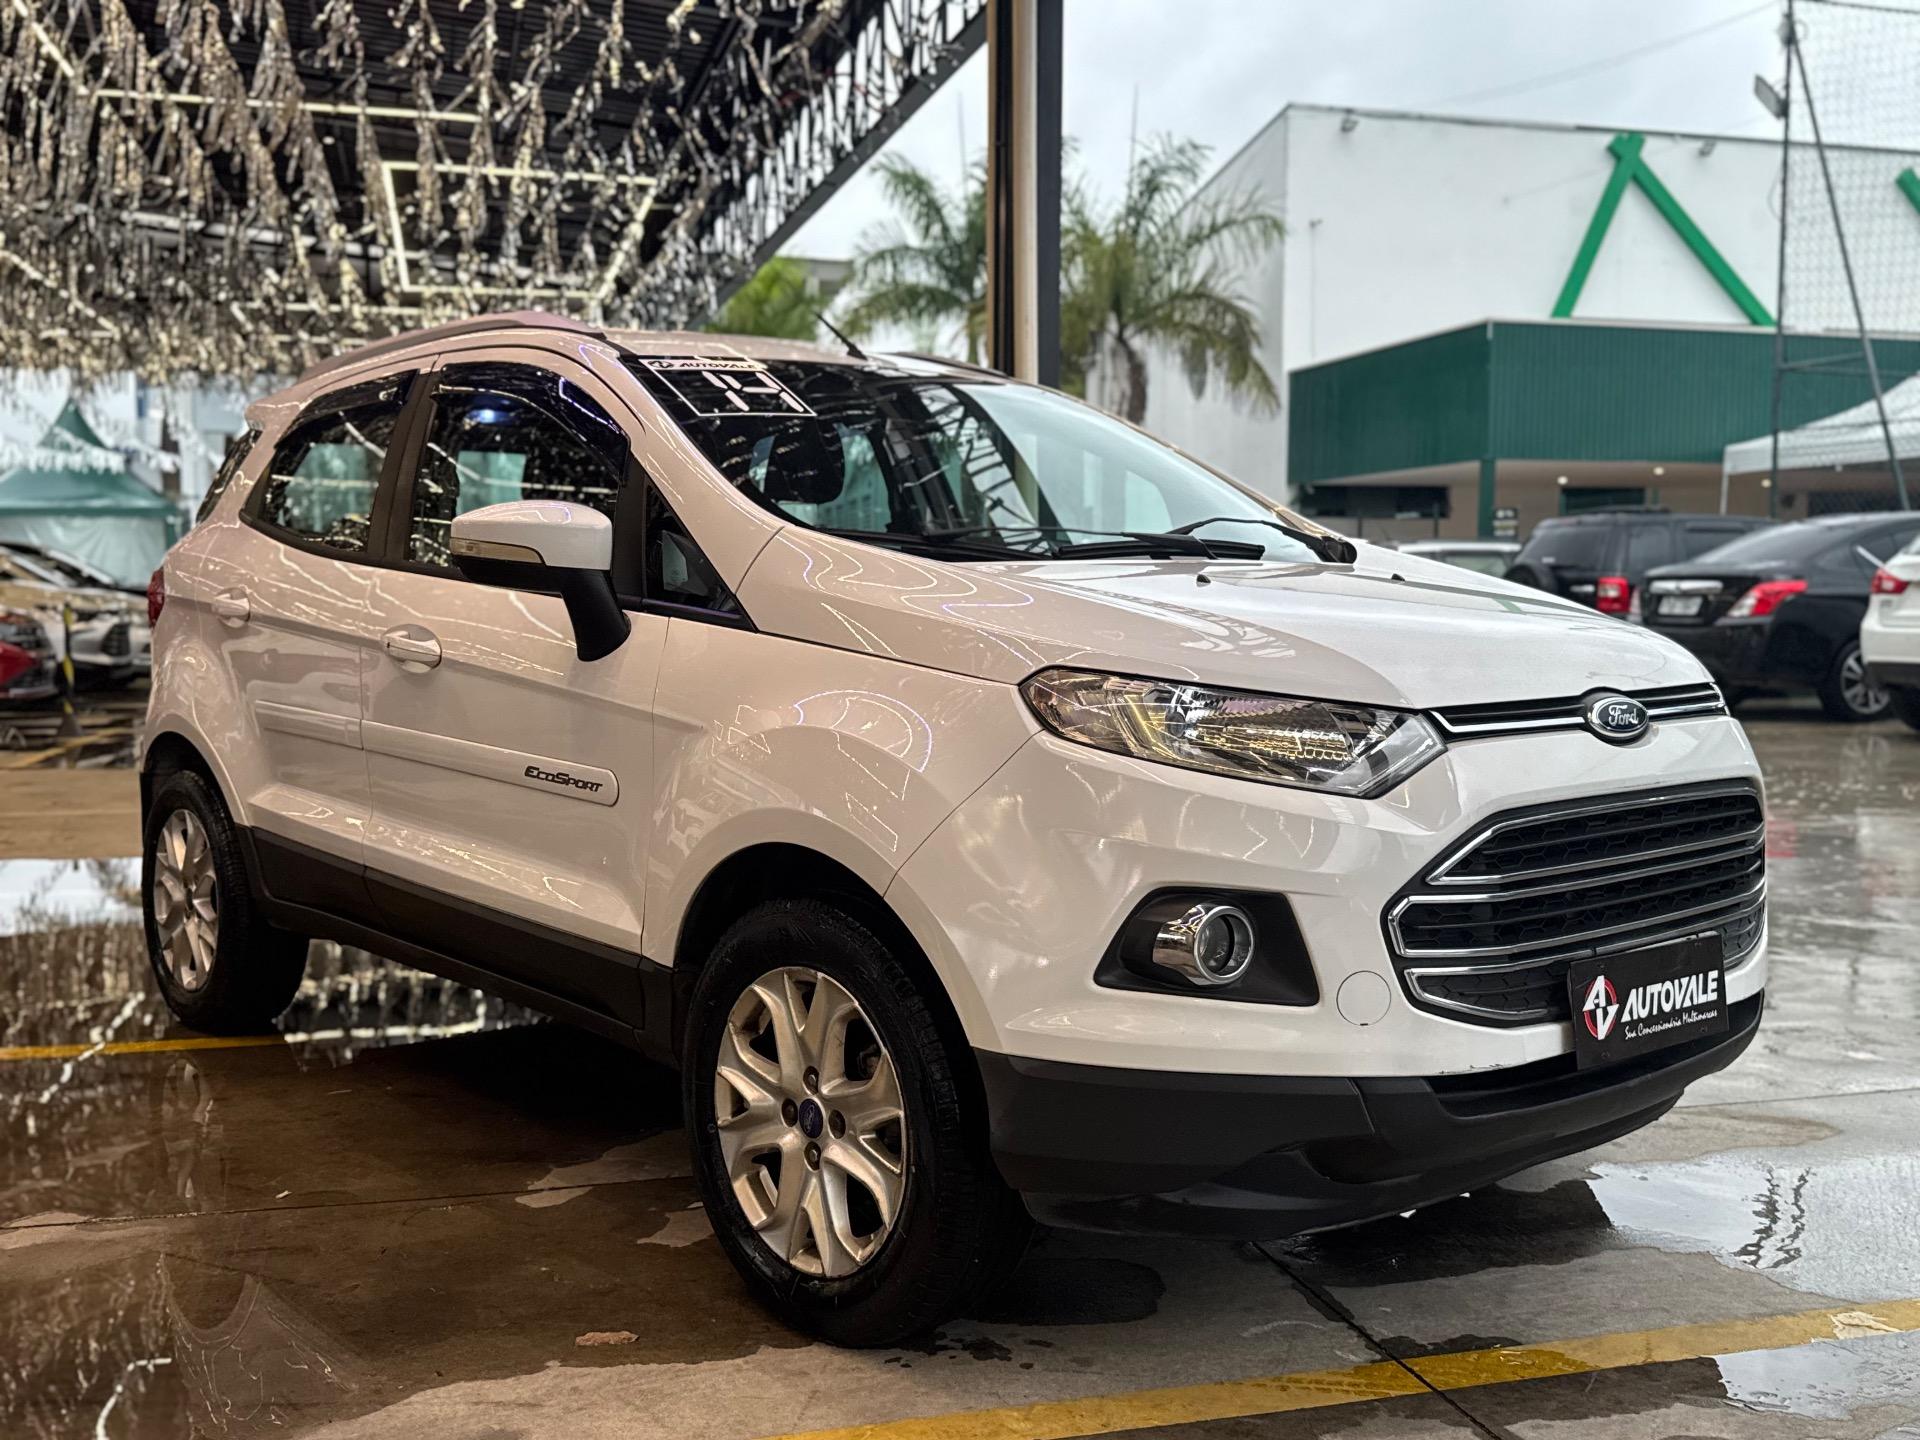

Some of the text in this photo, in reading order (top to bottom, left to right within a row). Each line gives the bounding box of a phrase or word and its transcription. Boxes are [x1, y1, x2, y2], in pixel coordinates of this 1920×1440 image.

[701, 371, 804, 412] 14
[1608, 704, 1639, 727] Ford
[1620, 970, 1719, 1023] AUTOVALE
